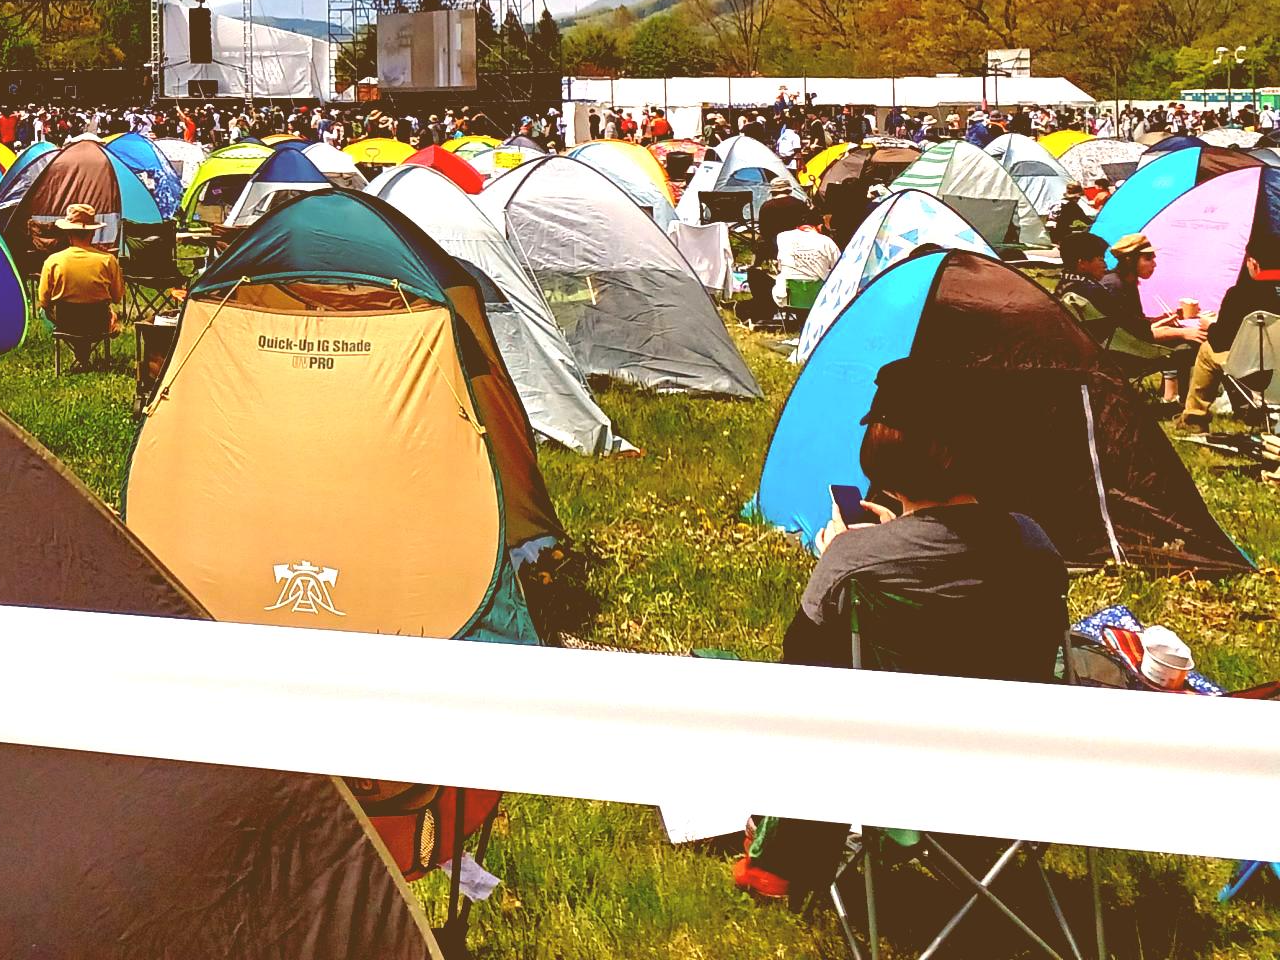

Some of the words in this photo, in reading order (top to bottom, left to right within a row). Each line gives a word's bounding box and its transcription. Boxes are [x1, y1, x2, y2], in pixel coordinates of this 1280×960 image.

[258, 335, 314, 352] Quick-Up
[317, 340, 330, 352] IG
[332, 339, 371, 352] Shade
[309, 356, 334, 370] PRO
